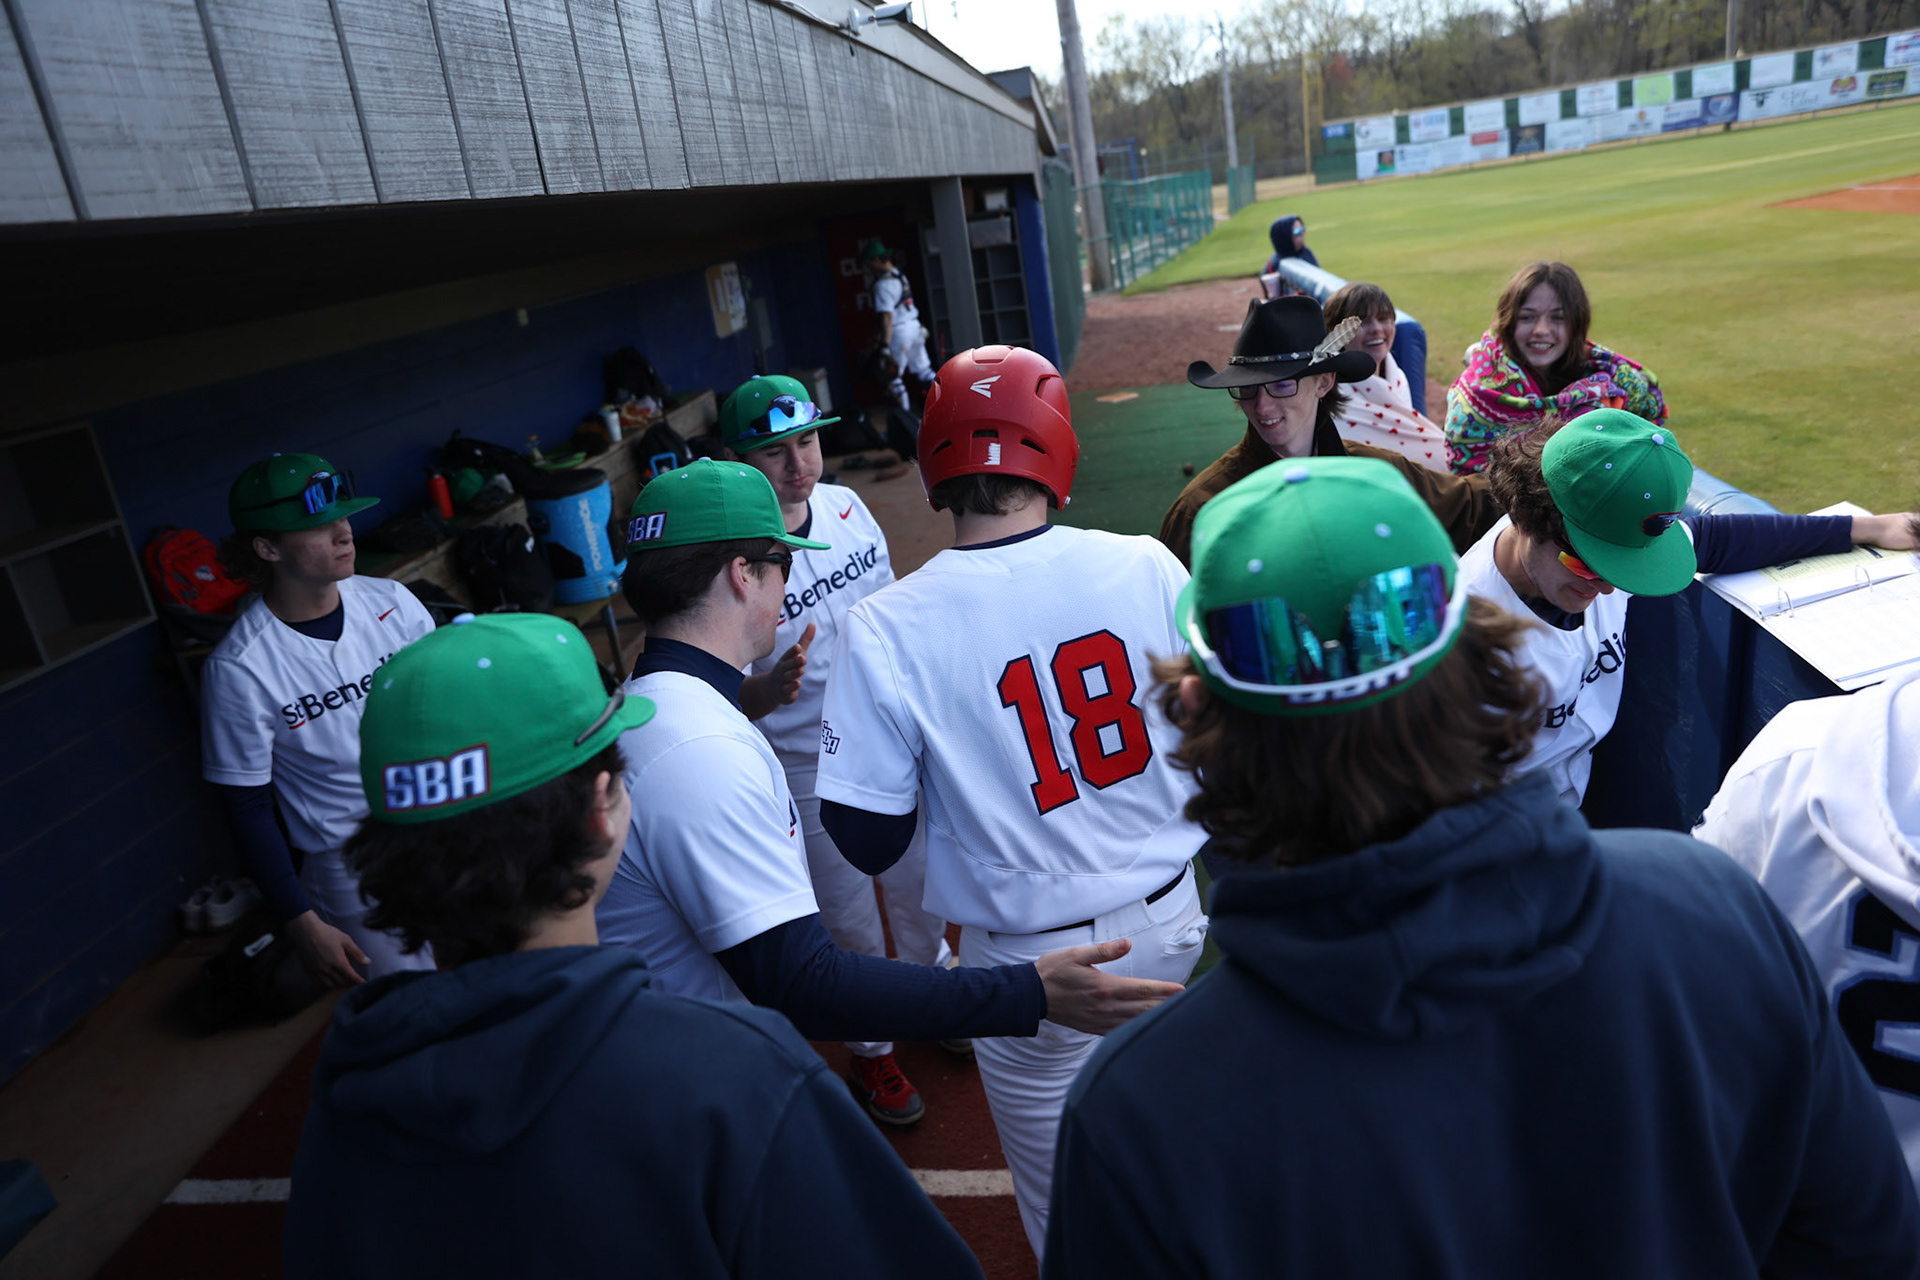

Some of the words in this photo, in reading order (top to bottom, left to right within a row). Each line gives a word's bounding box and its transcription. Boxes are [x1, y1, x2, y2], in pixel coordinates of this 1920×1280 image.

[626, 511, 667, 544] SBA
[997, 629, 1153, 816] 18
[383, 743, 490, 812] SBA
